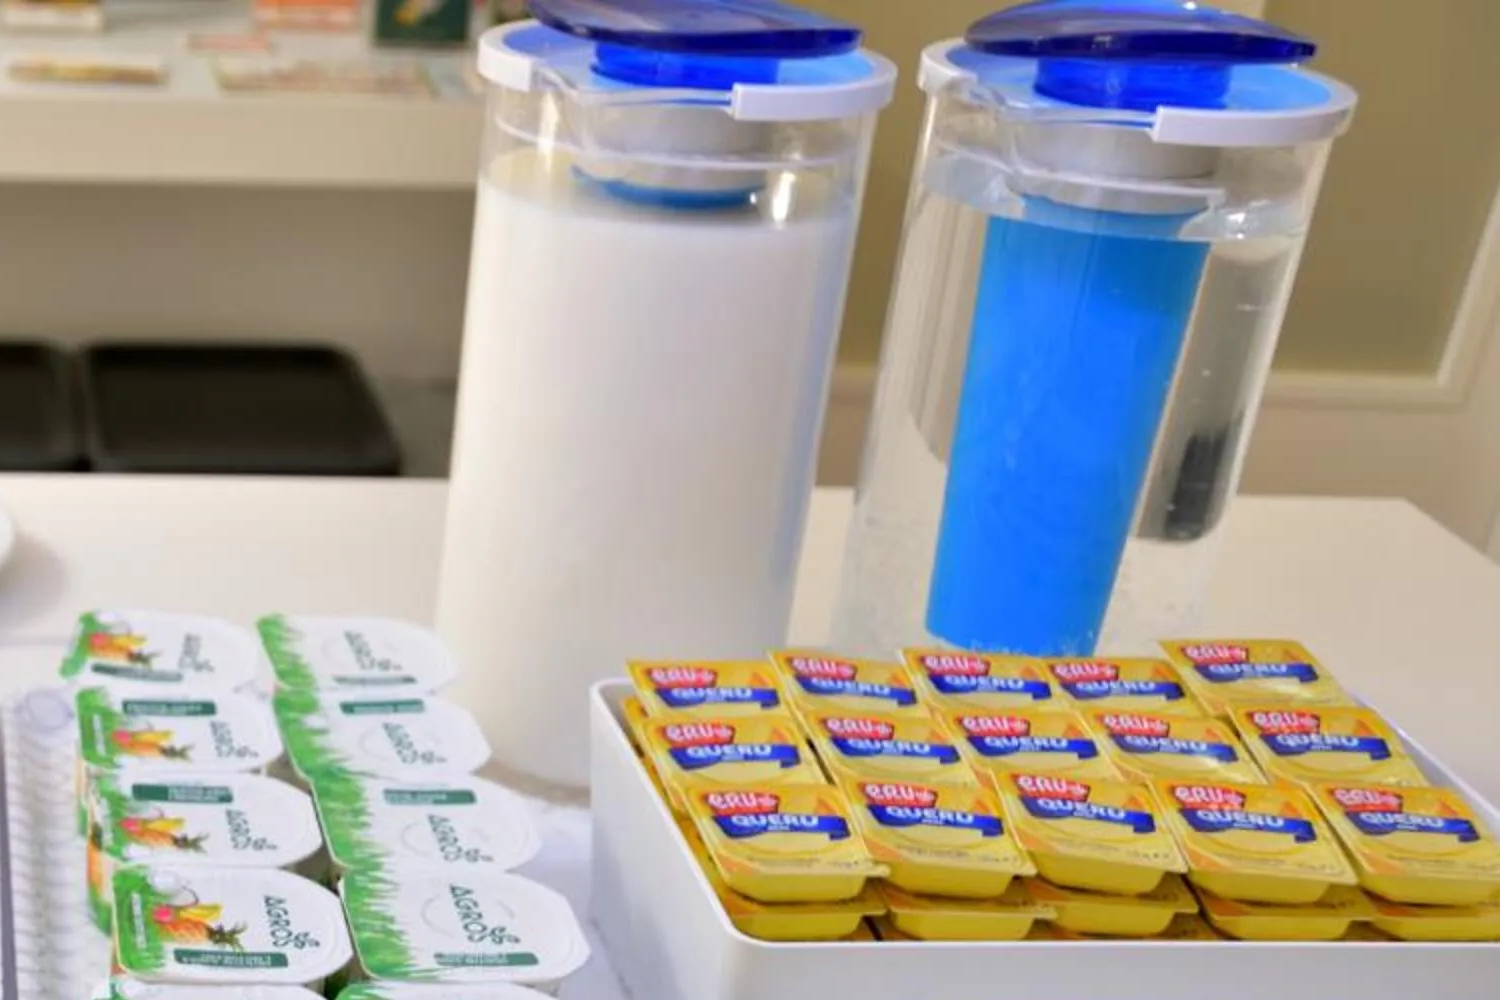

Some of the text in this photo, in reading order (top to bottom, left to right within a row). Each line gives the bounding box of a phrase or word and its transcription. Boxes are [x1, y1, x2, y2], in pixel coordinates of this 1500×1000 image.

[885, 805, 975, 824] QUERU
[1036, 797, 1126, 819] QUERU
[730, 814, 820, 828] QUERU
[1196, 809, 1286, 828] QUERU
[263, 894, 321, 949] AGROS
[449, 883, 522, 945] AGROS
